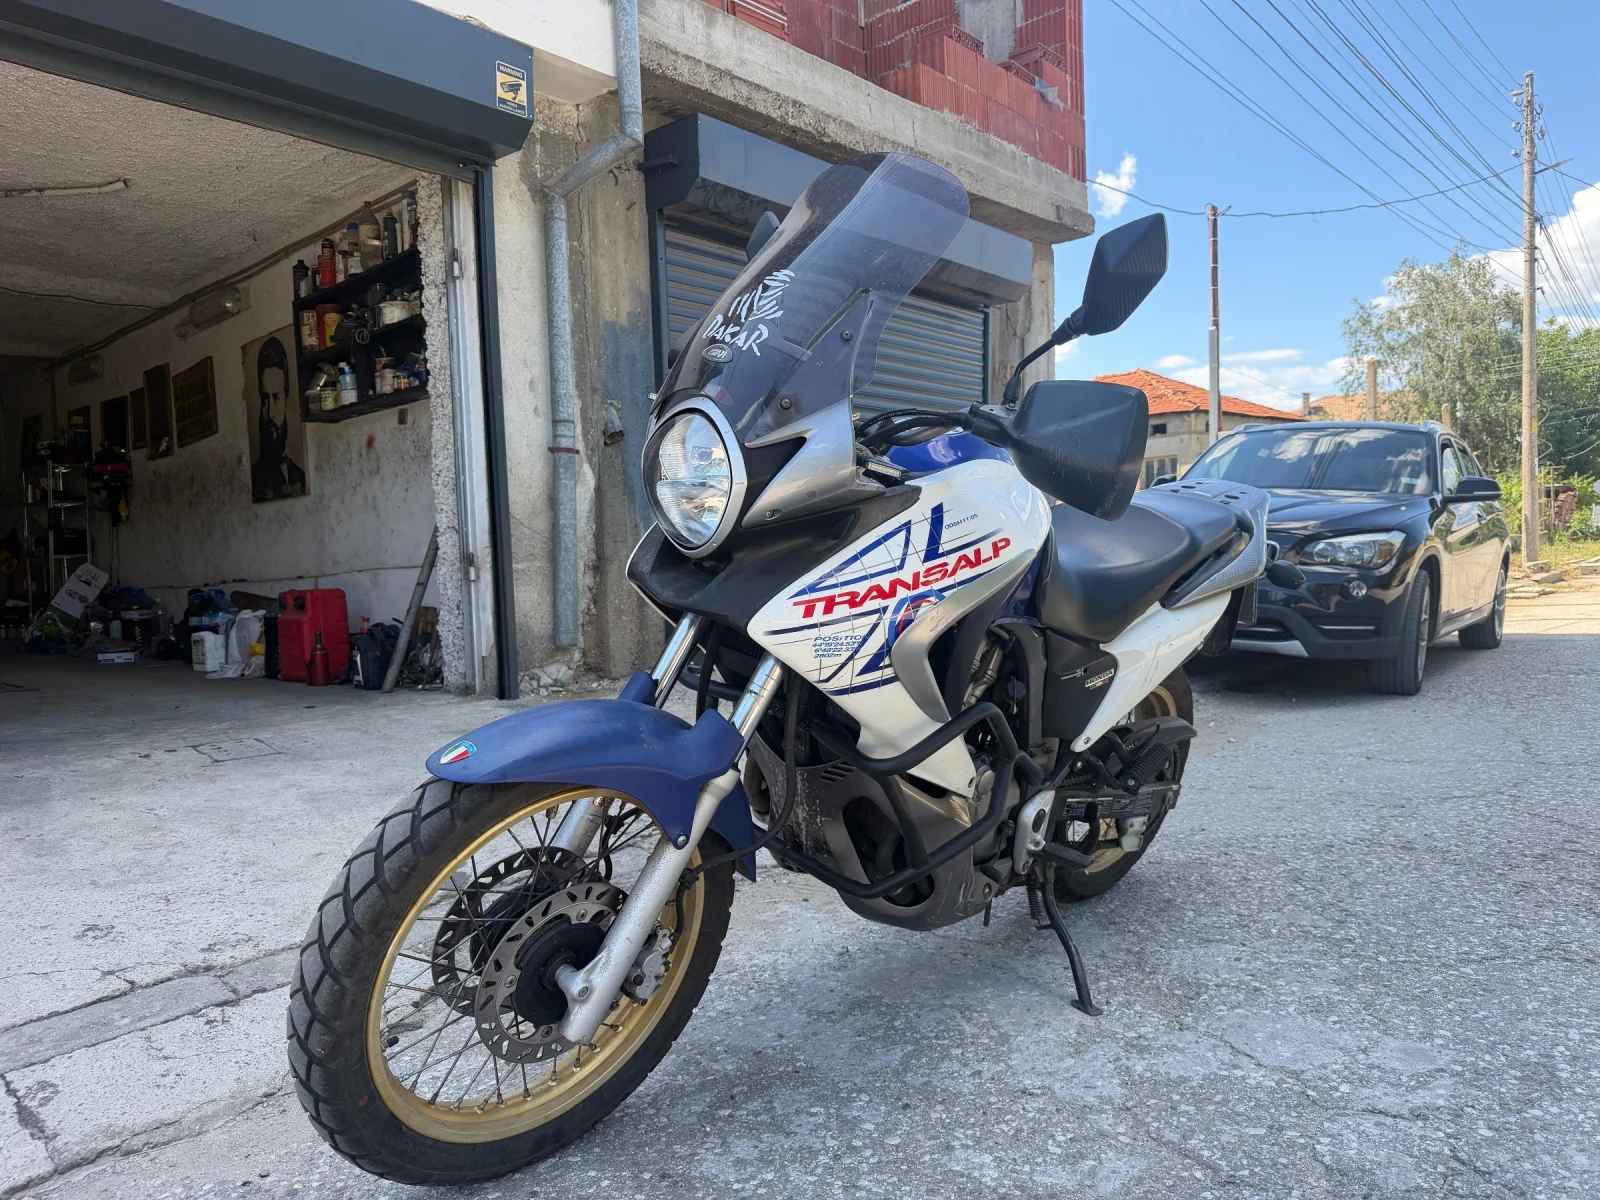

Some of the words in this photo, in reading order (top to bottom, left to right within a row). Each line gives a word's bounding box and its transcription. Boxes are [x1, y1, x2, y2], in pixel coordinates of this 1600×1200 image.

[499, 65, 523, 79] WARNING
[702, 313, 769, 357] DAKAR
[792, 537, 1011, 618] TRANSALP
[1086, 670, 1113, 686] HONDA
